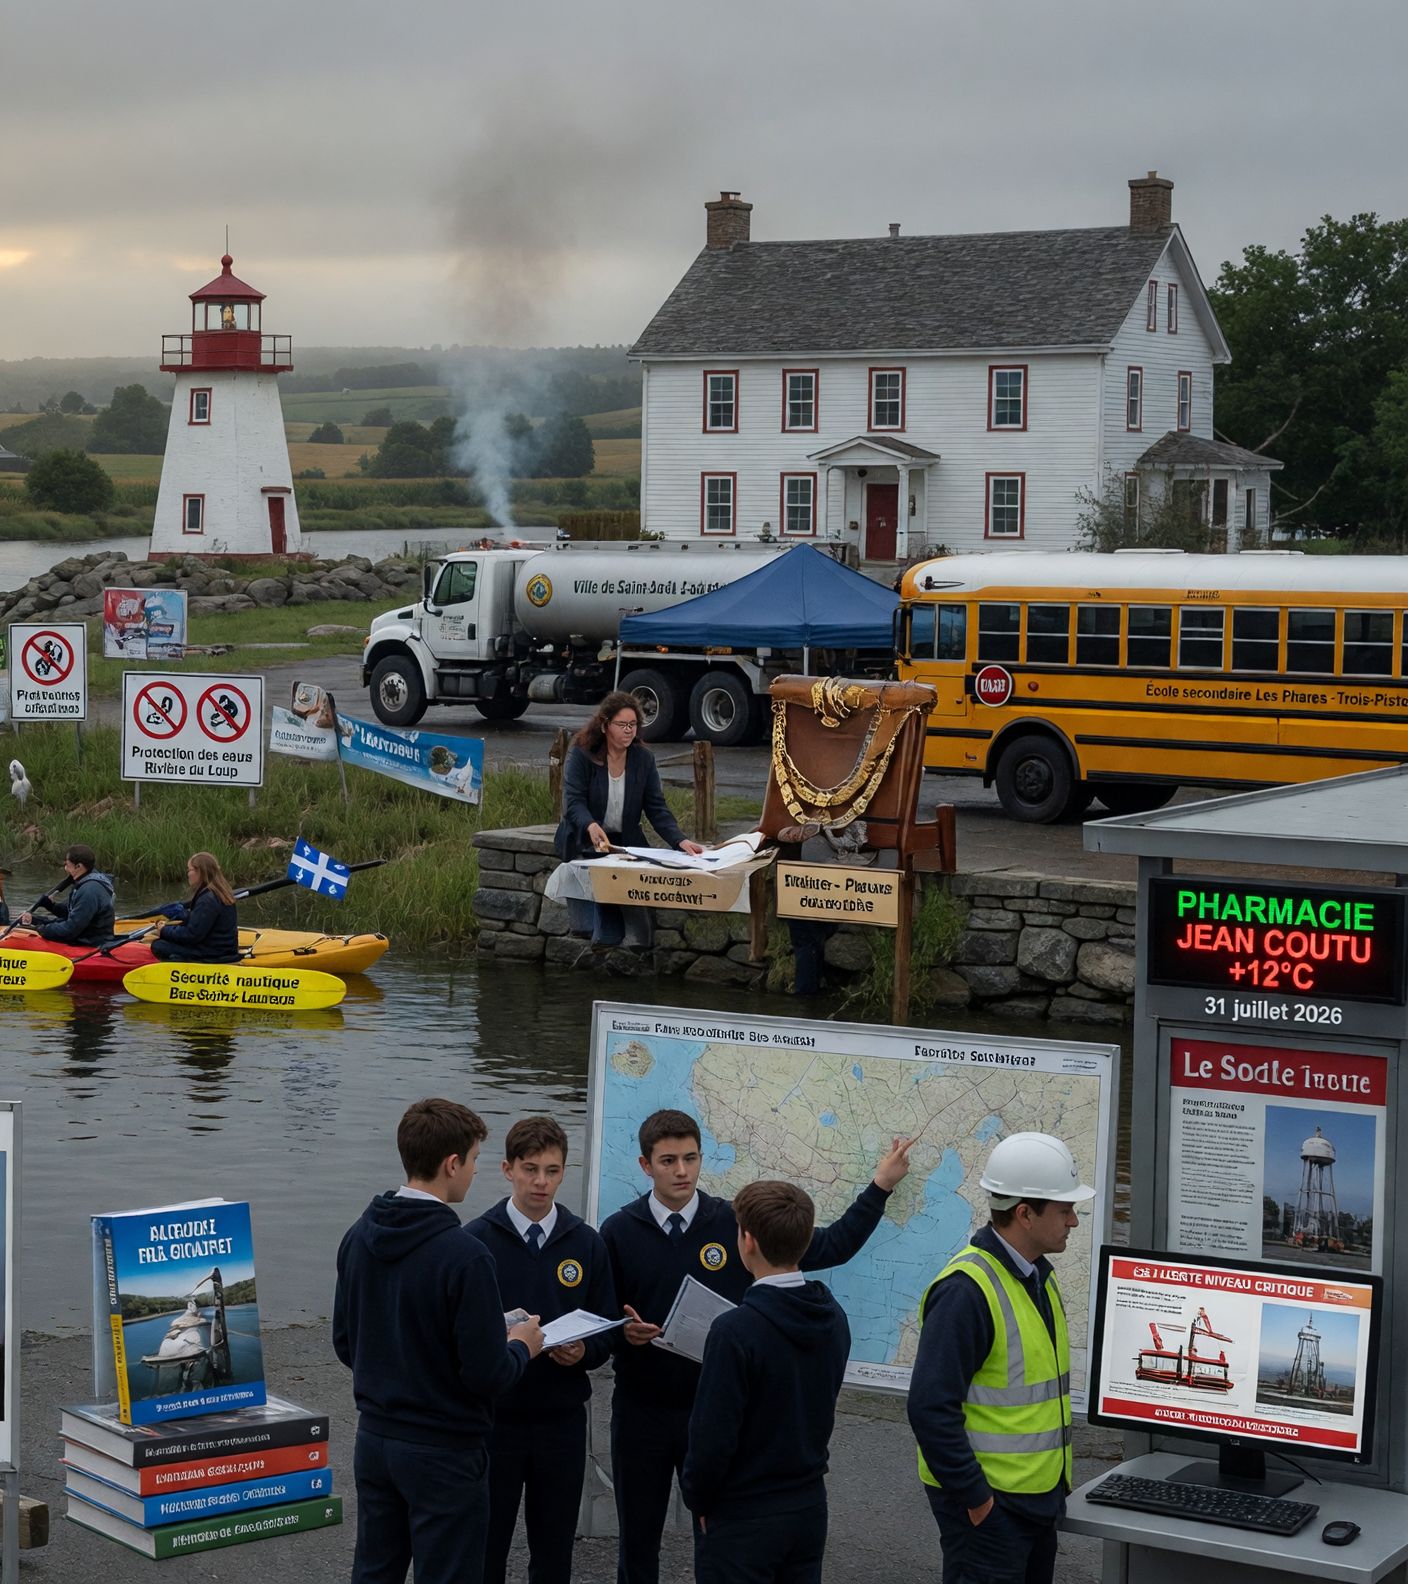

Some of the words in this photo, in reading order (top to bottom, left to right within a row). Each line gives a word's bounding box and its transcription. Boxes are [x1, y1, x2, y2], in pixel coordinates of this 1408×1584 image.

[574, 580, 598, 594] Ville
[601, 580, 615, 594] de
[1146, 681, 1179, 697] École
[1182, 688, 1252, 700] secondaire
[1256, 688, 1278, 701] Les
[1282, 690, 1328, 704] Phares
[198, 749, 219, 760] des
[189, 765, 204, 775] du
[208, 765, 238, 779] Loup
[1177, 890, 1375, 931] PHARMACIE
[1177, 923, 1255, 953] JEAN
[1263, 929, 1371, 964] COUTU
[236, 975, 300, 990] nautique
[1229, 959, 1314, 990] +12°C
[1205, 996, 1225, 1015] 31
[1232, 999, 1289, 1021] juillet
[1294, 1003, 1343, 1025] 2026
[1183, 1052, 1214, 1079] Le
[1205, 1274, 1252, 1290] NIVEAU
[1255, 1281, 1314, 1298] CRITIQUE
